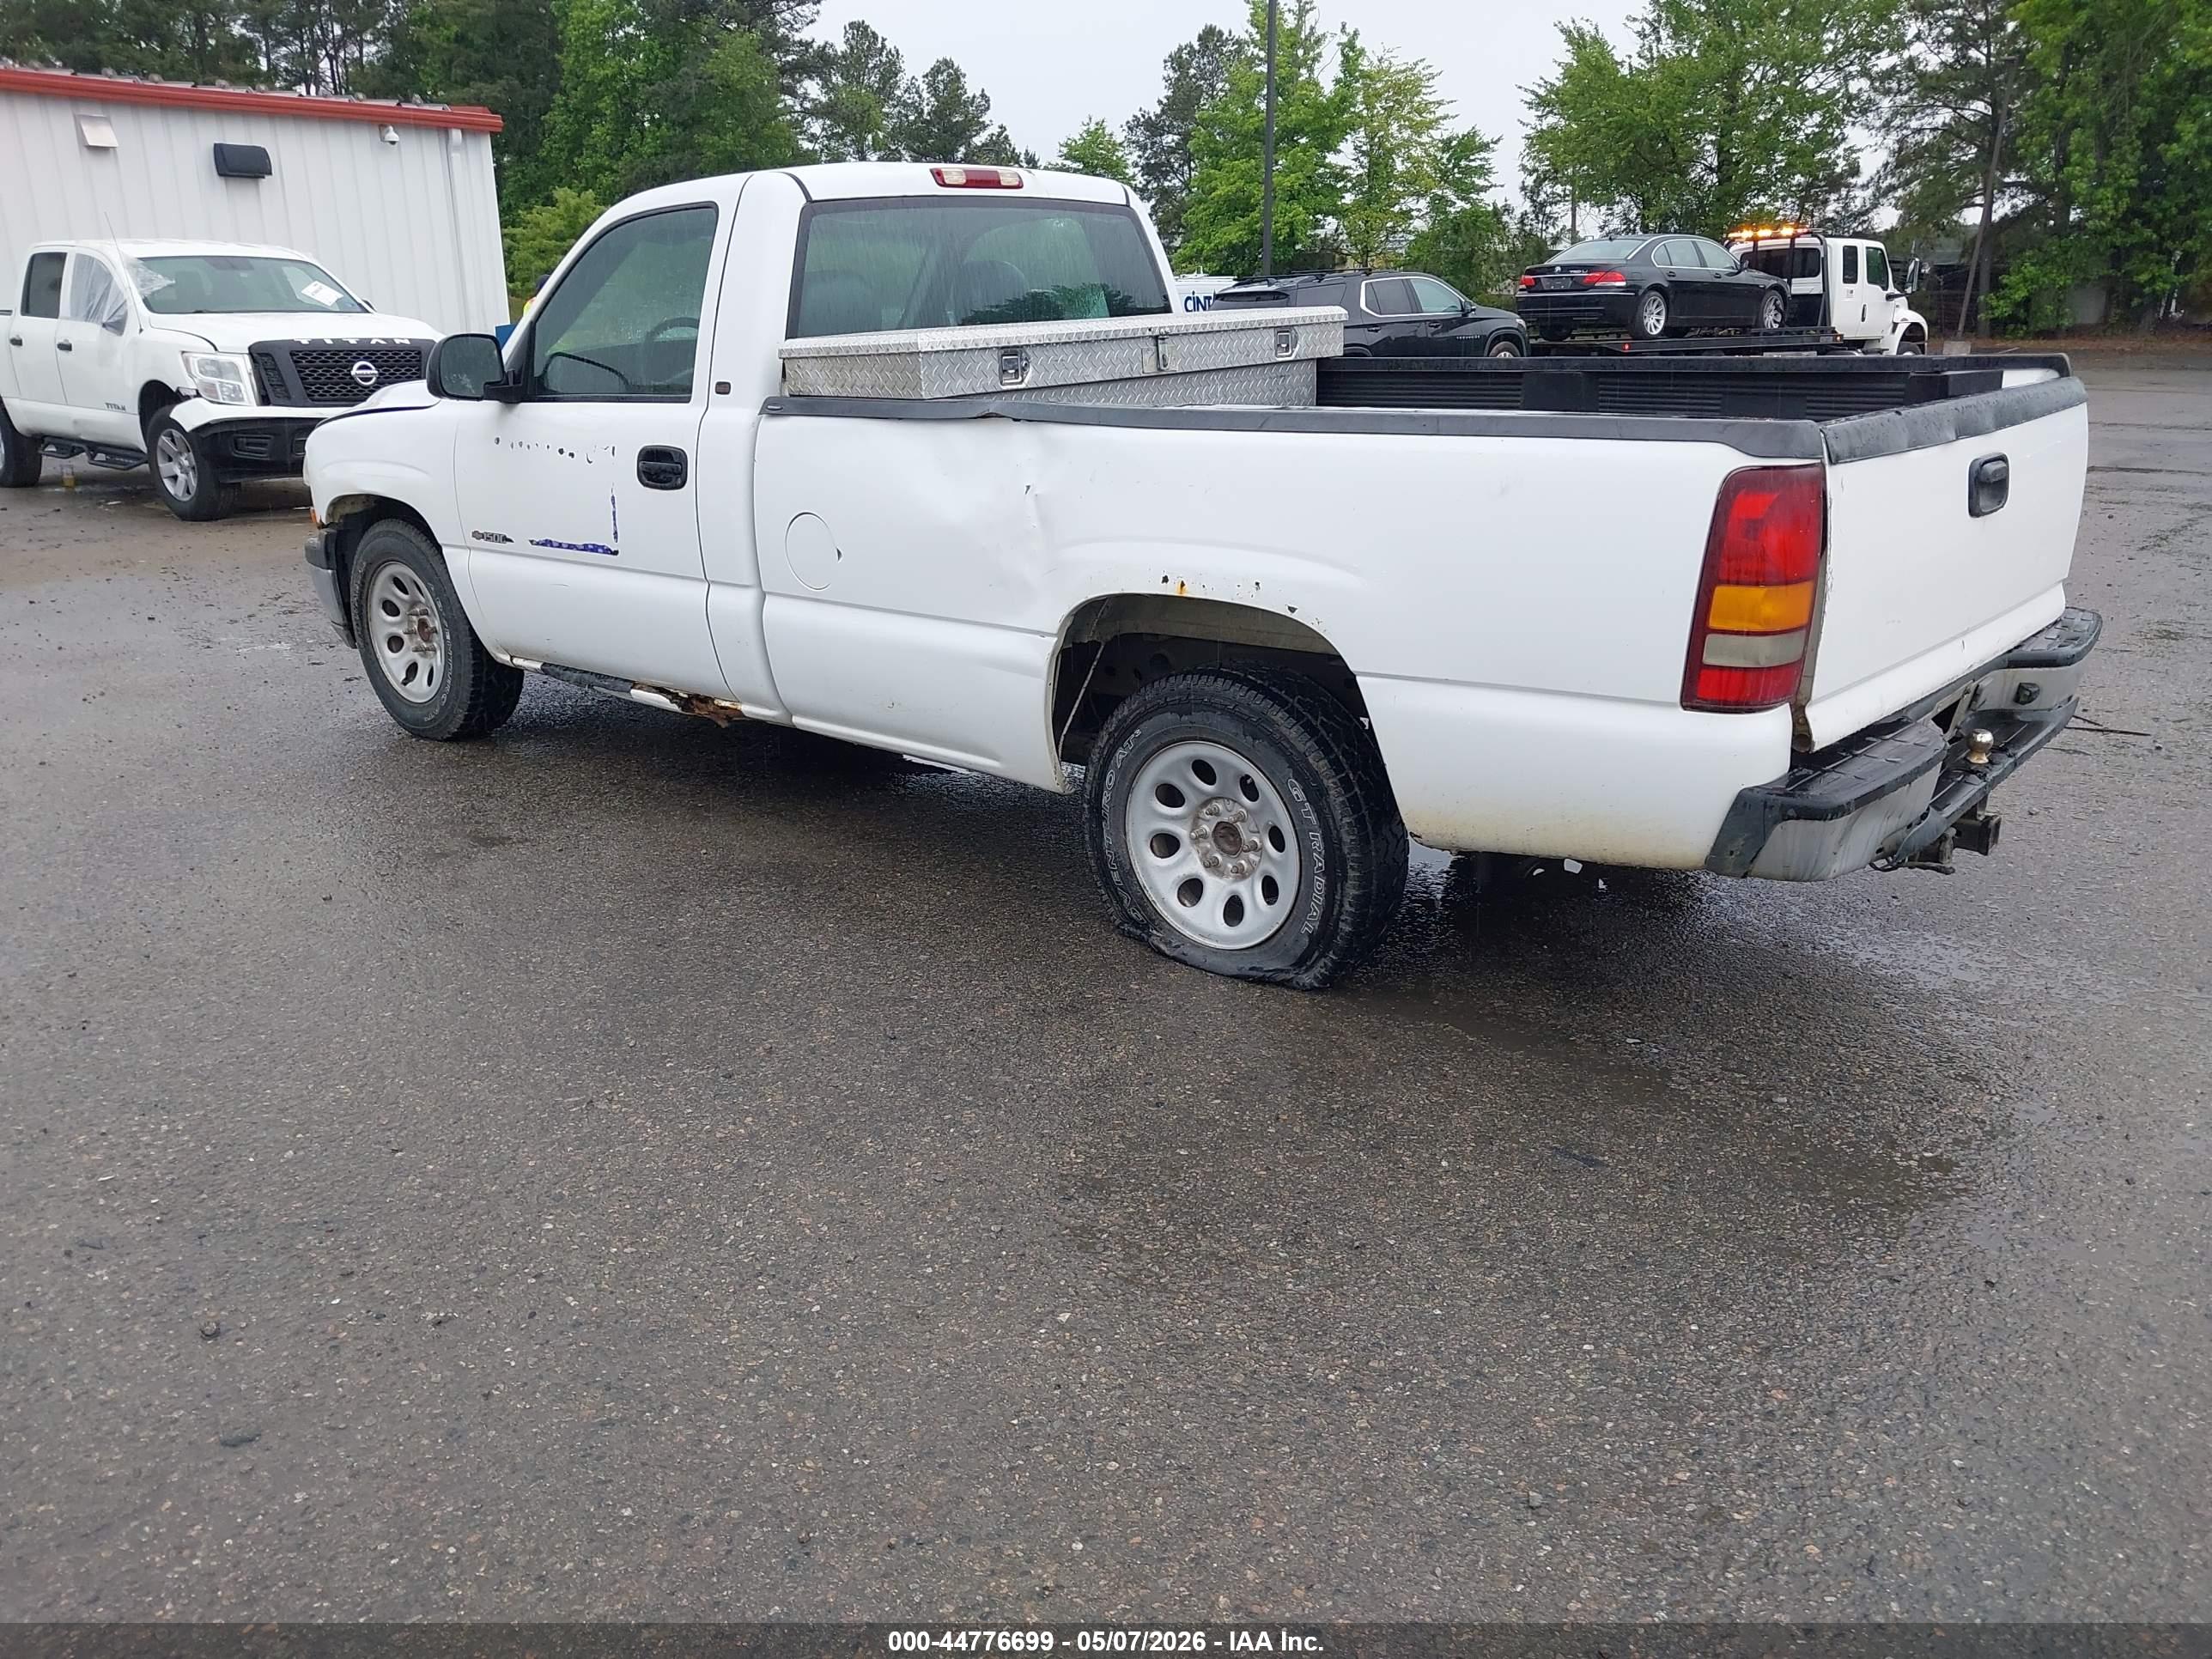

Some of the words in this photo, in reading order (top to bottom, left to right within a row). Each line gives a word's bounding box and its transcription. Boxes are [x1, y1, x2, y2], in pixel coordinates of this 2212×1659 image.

[1184, 289, 1216, 313] CINT
[1287, 778, 1318, 825] GT
[1101, 769, 1148, 925] DVENTURO
[1300, 831, 1325, 934] RADIAL
